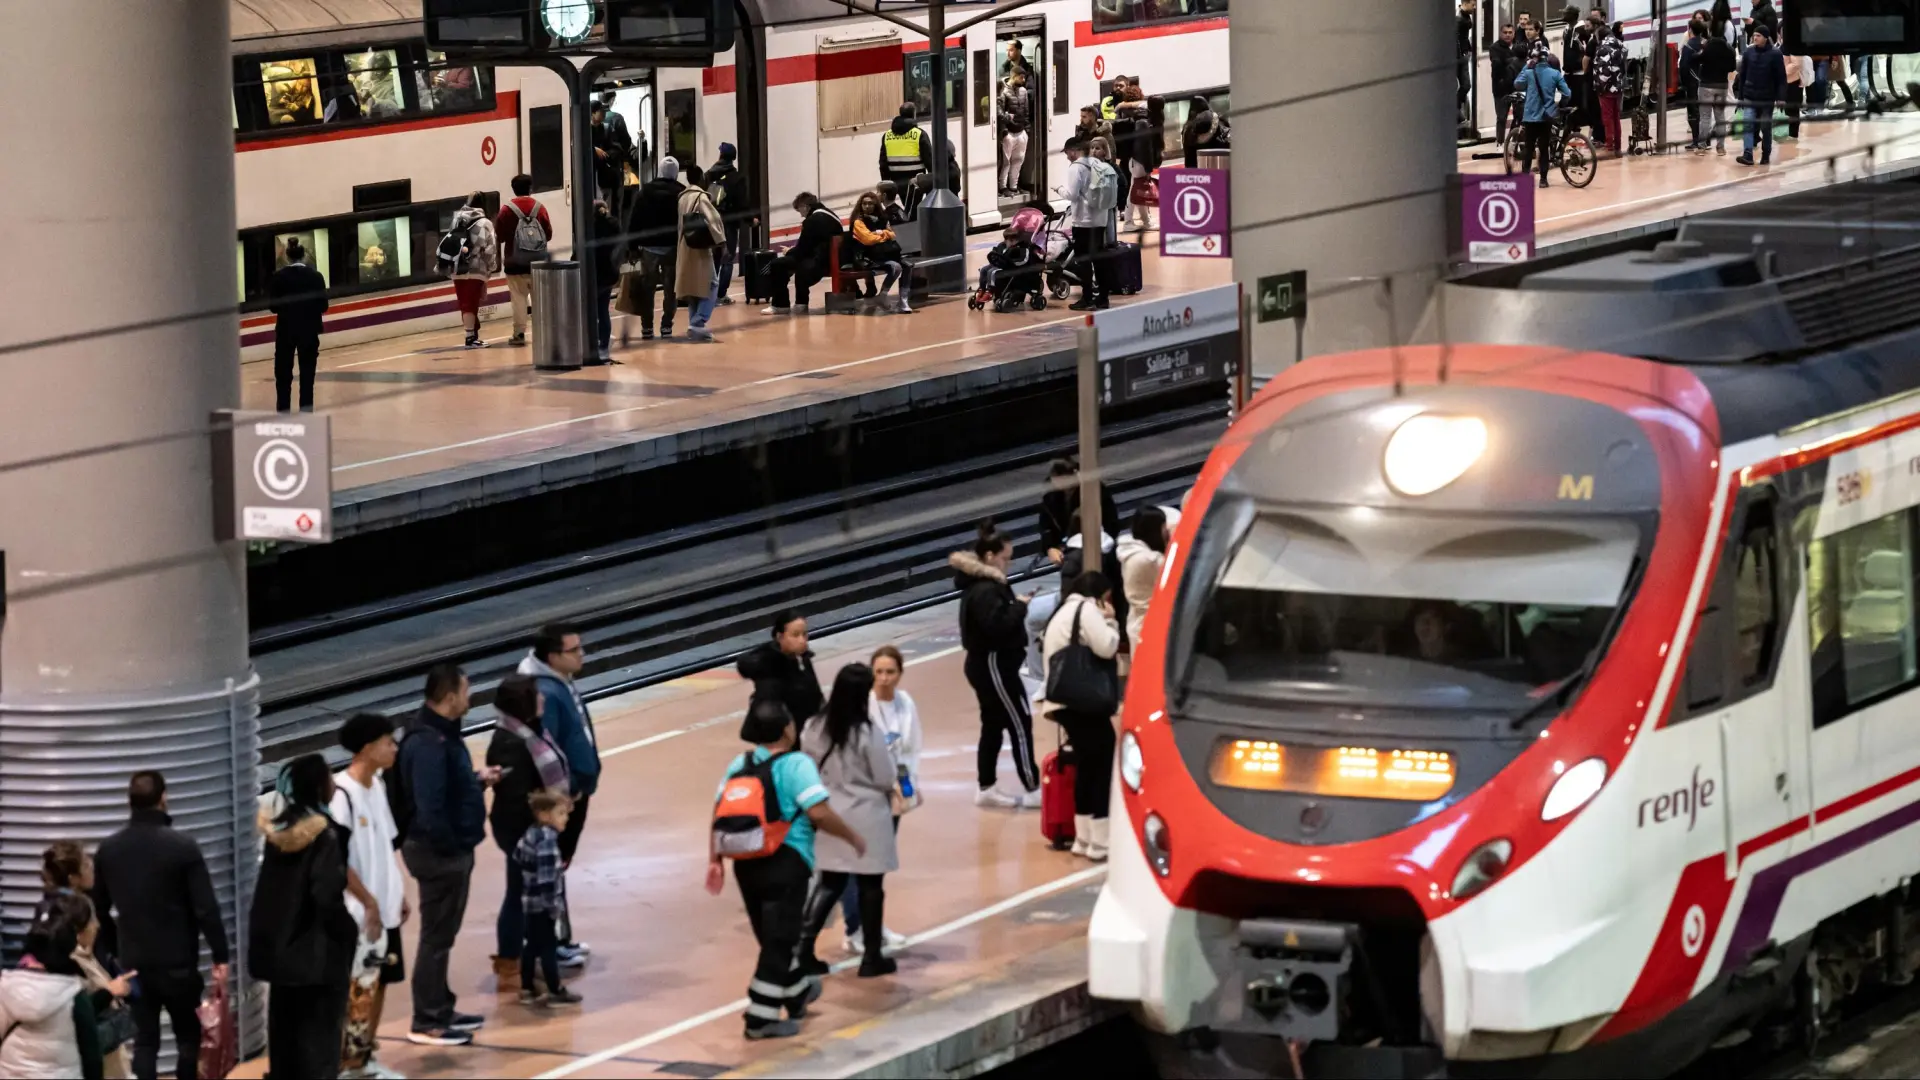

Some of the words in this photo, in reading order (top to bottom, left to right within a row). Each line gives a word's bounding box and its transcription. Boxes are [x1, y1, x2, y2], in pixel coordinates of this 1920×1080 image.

[1175, 174, 1211, 184] SECTOR
[1480, 181, 1516, 191] SECTOR
[1184, 193, 1206, 221] D
[1488, 200, 1512, 229] D
[1143, 309, 1181, 337] Atocha
[255, 423, 305, 436] SECTOR
[265, 448, 297, 491] C
[1557, 474, 1594, 500] M
[1638, 764, 1715, 832] renfe
